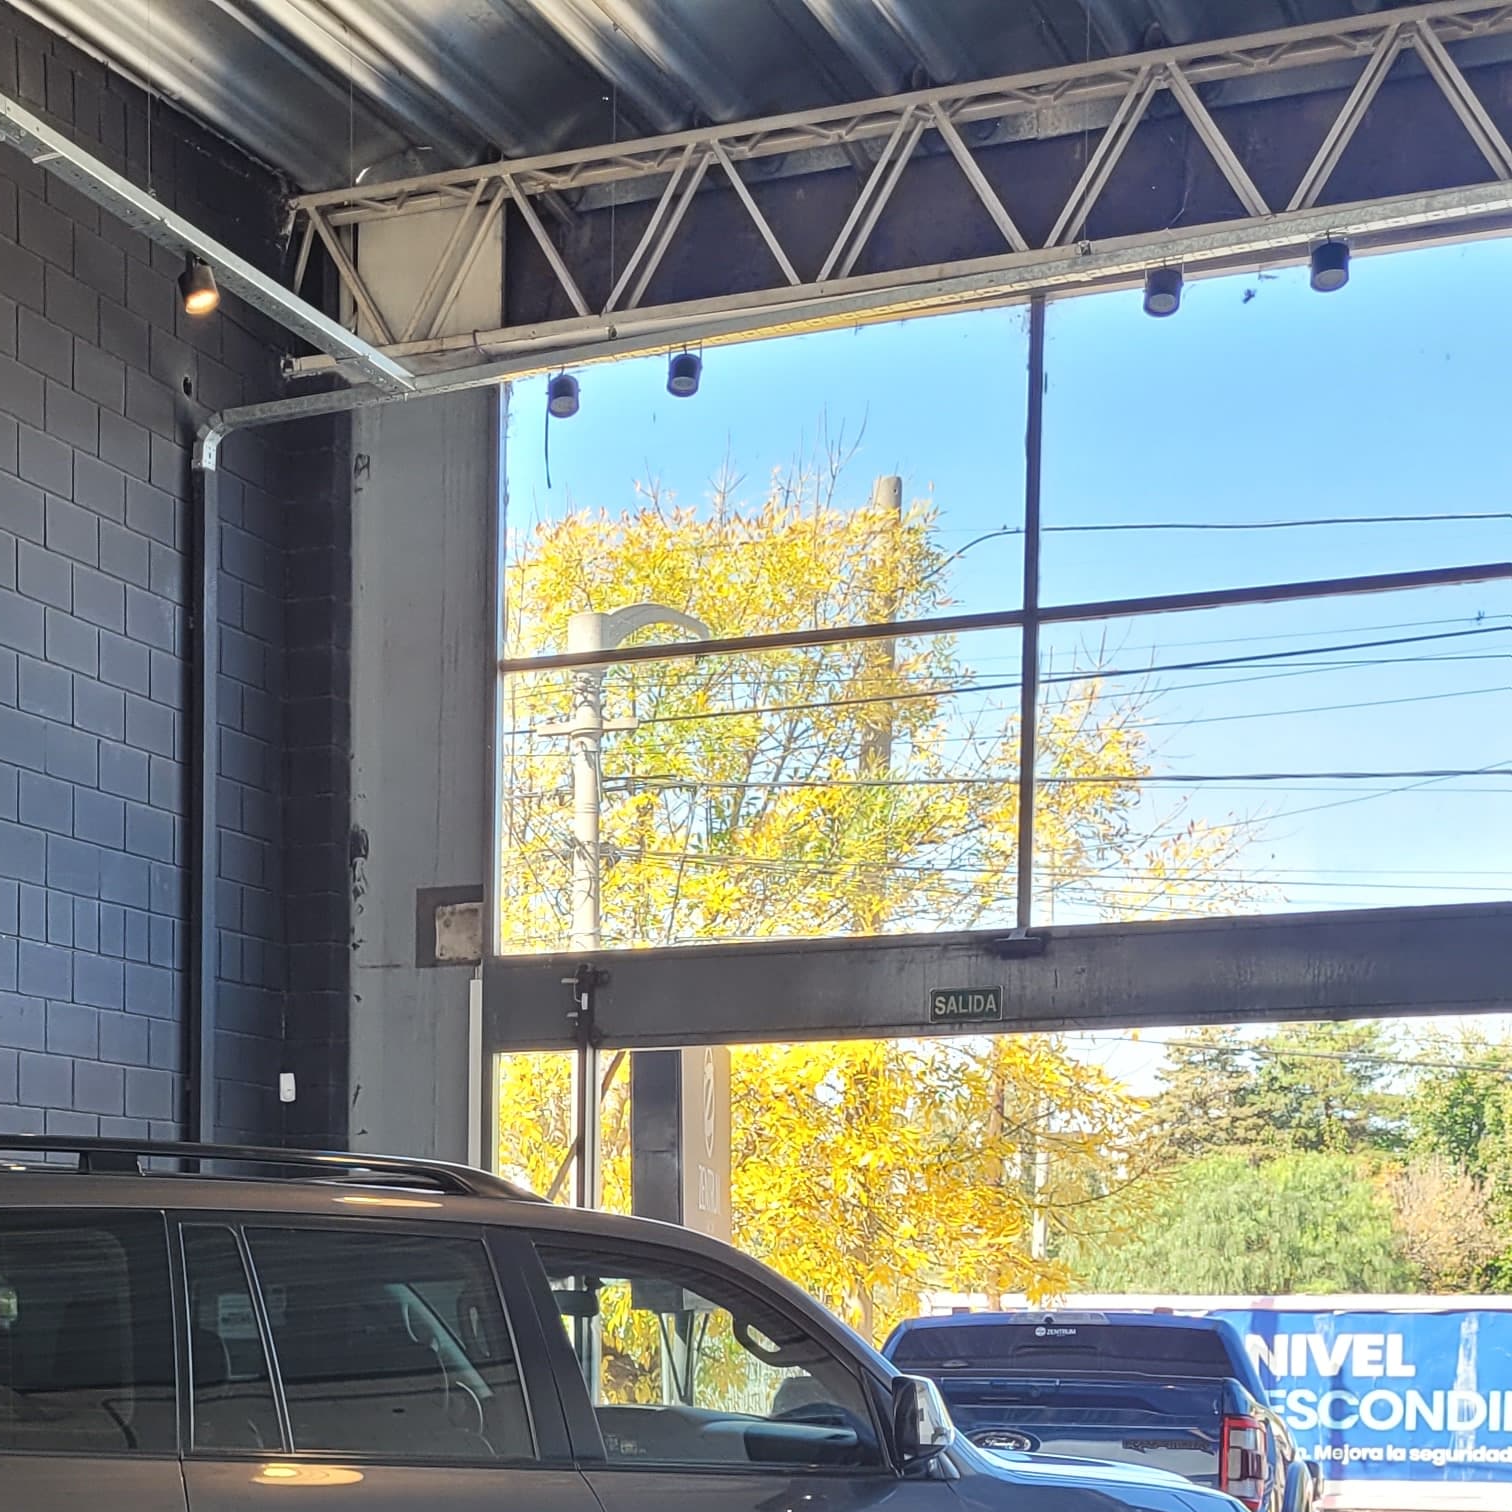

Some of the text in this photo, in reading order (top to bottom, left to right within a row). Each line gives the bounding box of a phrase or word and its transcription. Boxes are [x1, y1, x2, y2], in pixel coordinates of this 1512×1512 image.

[934, 994, 997, 1015] SALIDA
[1245, 1333, 1416, 1377] NIVEL
[1264, 1388, 1512, 1432] SCONDI
[1313, 1444, 1384, 1466] Mejora
[1386, 1444, 1407, 1462] la
